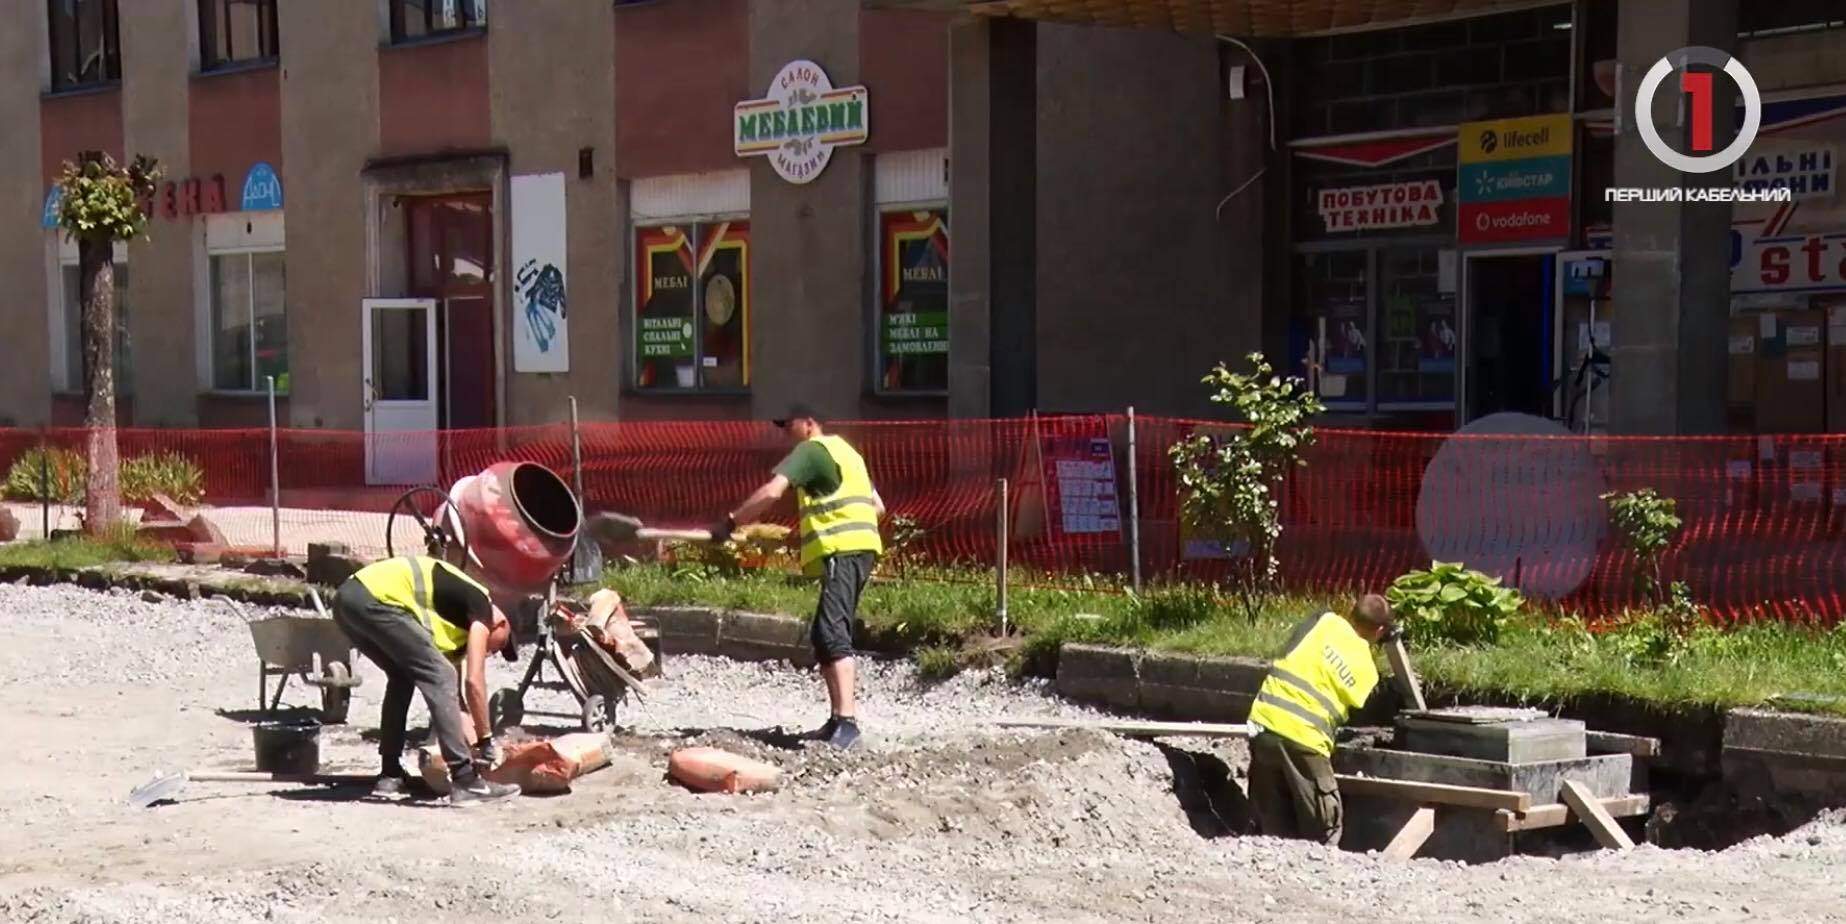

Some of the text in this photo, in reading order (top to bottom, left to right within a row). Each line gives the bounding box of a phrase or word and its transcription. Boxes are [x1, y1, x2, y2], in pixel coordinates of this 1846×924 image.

[781, 67, 820, 88] САЛОН
[738, 92, 863, 143] МЕБЛЕВИЙ
[1503, 128, 1550, 149] lifecell
[777, 151, 826, 178] МАГАЗИН
[1322, 183, 1439, 209] ПОБУТОВА
[1328, 204, 1432, 228] ТЕХНІКА
[1491, 212, 1551, 228] vodafone
[654, 275, 688, 289] МЕБЛІ
